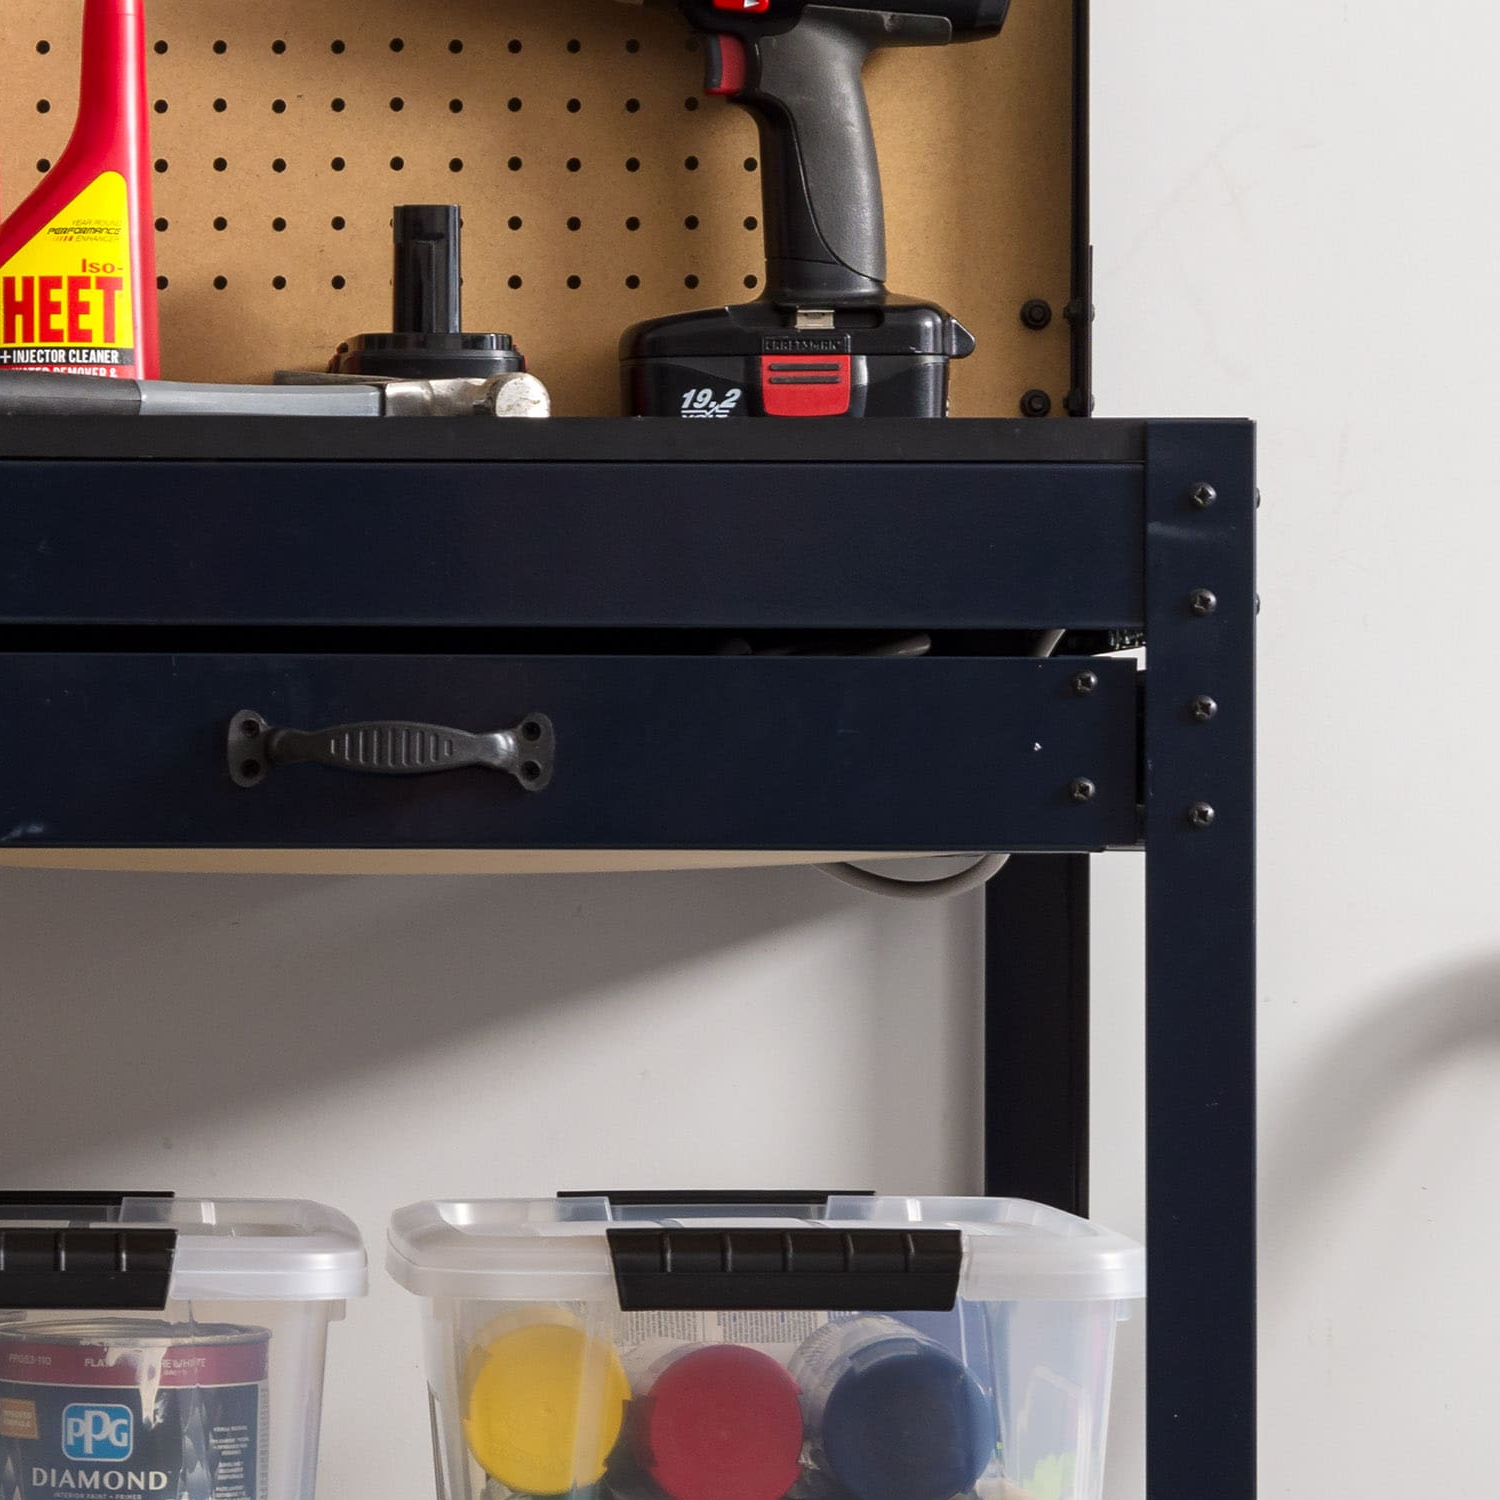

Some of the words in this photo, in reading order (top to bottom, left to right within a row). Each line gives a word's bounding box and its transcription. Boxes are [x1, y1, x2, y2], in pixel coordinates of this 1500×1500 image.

[82, 258, 124, 273] Iso-
[3, 276, 123, 344] HEET
[68, 349, 120, 364] CLEANER
[681, 388, 742, 410] 19.2
[65, 1410, 129, 1454] PPG
[32, 1467, 168, 1491] DIAMOND
